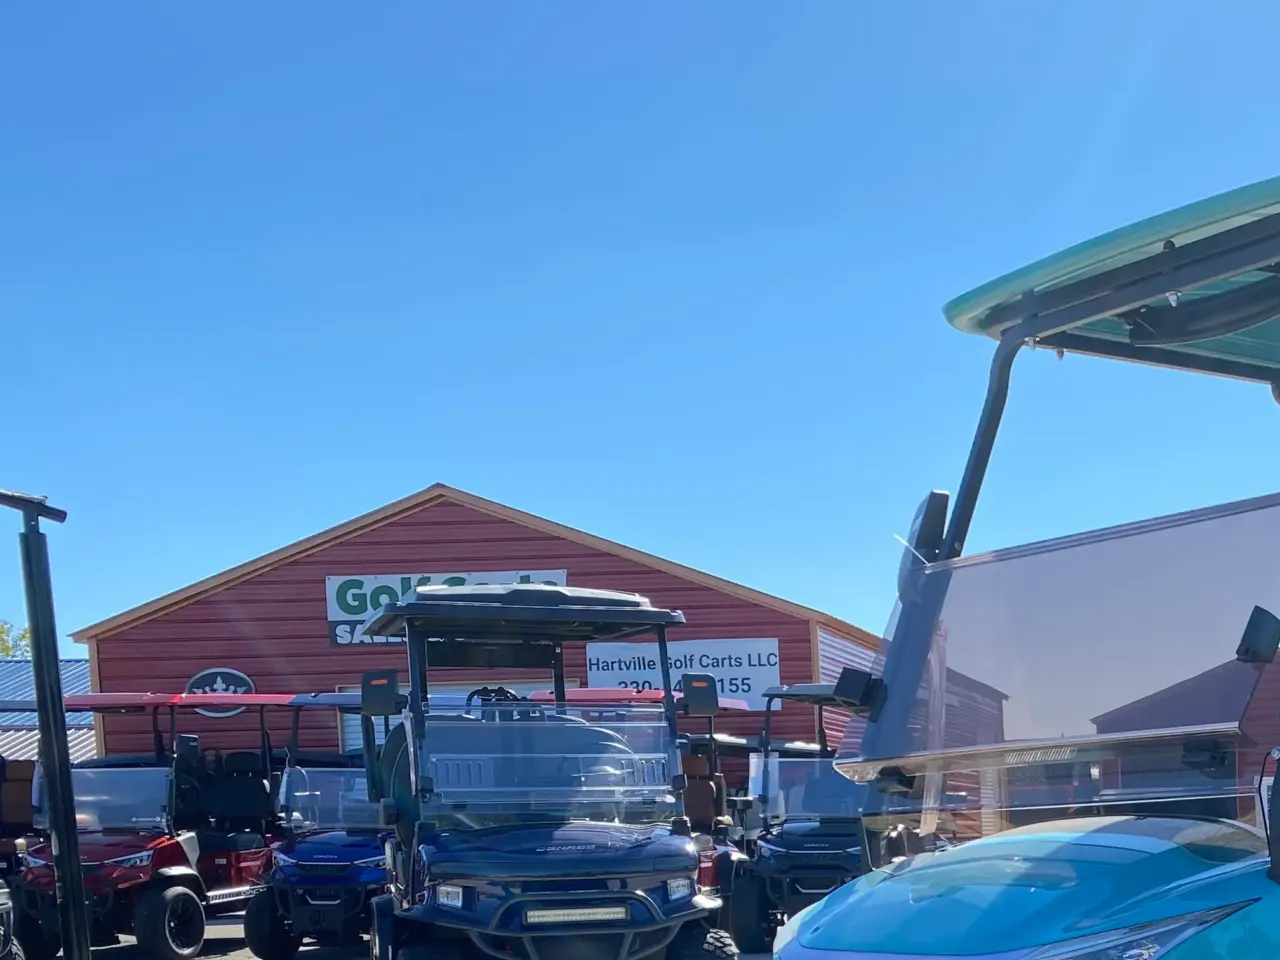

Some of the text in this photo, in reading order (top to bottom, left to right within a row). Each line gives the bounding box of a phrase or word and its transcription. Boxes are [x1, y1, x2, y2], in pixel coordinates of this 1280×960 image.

[336, 576, 431, 615] Go
[588, 655, 657, 672] Hartville
[699, 654, 743, 669] Carts
[747, 652, 778, 667] LLC
